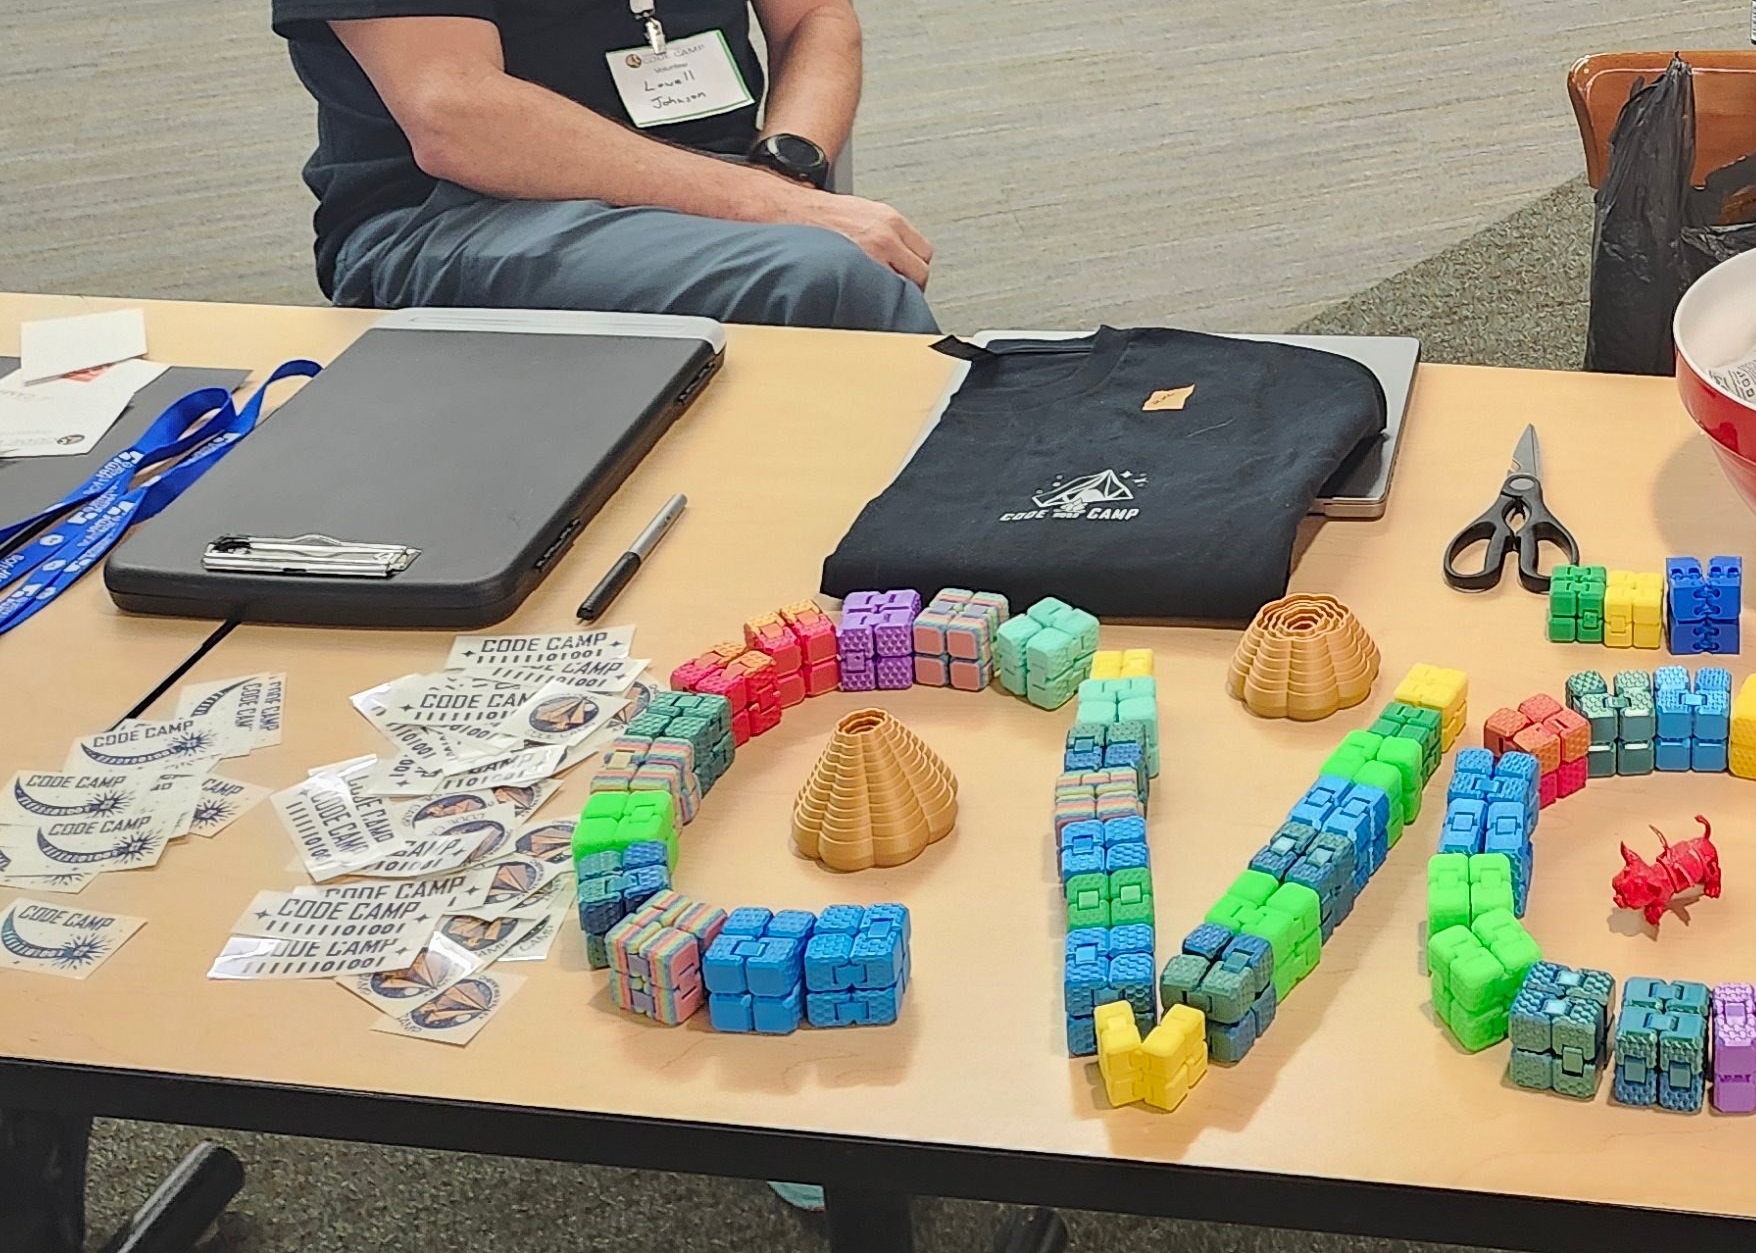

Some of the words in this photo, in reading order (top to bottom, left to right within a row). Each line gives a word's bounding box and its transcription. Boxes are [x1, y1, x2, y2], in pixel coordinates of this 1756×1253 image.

[1000, 510, 1049, 521] CODE
[1086, 508, 1140, 520] CAMP
[481, 639, 540, 653] CODE
[546, 632, 608, 650] CAMP
[420, 693, 483, 709] CODE
[486, 692, 537, 708] CAM
[93, 730, 139, 748] CODE
[145, 720, 194, 739] CAMP
[26, 774, 76, 788] CODE
[75, 775, 127, 789] CAMP
[201, 777, 245, 797] CAMP
[48, 821, 98, 836] CODE
[100, 815, 152, 834] CAMP
[395, 876, 466, 899] CAMP
[18, 905, 68, 925] CODE
[63, 910, 115, 931] CAMP
[277, 898, 349, 920] CODE
[349, 901, 421, 921] CAMP
